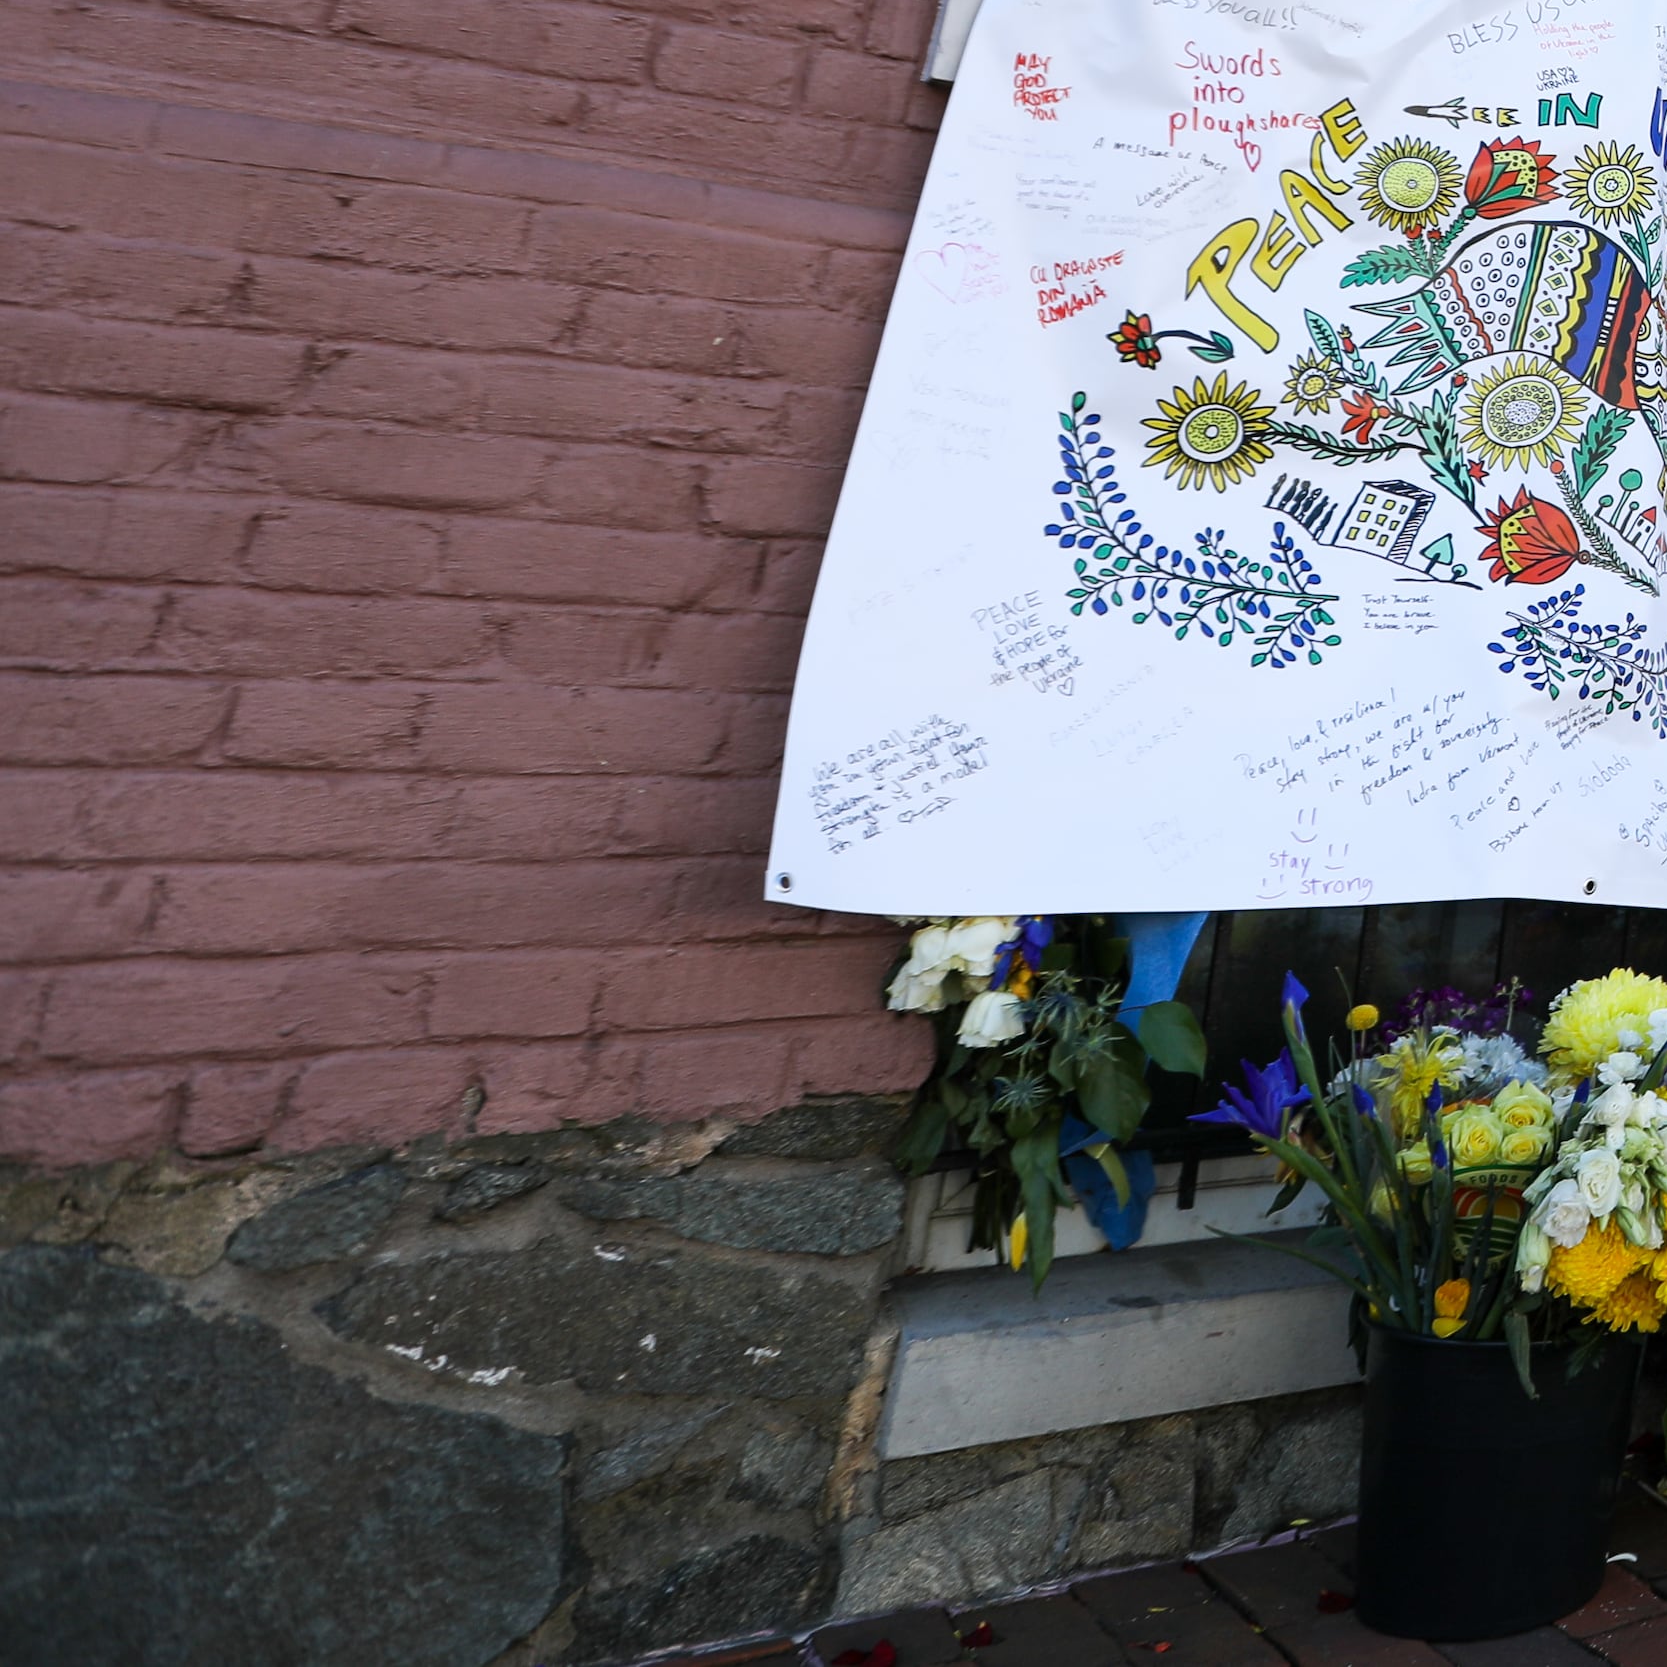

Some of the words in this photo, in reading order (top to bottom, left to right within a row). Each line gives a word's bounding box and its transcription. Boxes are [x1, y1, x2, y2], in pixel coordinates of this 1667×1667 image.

[1447, 11, 1519, 54] BLESS
[1014, 53, 1052, 73] MAY
[1175, 40, 1281, 77] Swords
[1014, 73, 1046, 88] GOD
[1536, 69, 1558, 81] USA
[1536, 75, 1580, 92] UKRAINE
[1013, 87, 1072, 107] PROTECT
[1193, 75, 1244, 104] into
[1025, 107, 1059, 121] YOU
[1168, 106, 1322, 150] ploughshares
[1092, 137, 1104, 150] A
[1185, 97, 1368, 353] PEACE
[1538, 92, 1603, 129] IN
[1030, 266, 1047, 283] CU
[1038, 282, 1066, 306] DIN
[971, 590, 1043, 631] PEACE
[994, 614, 1040, 645] LOVE
[1008, 633, 1047, 659] HOPE
[990, 669, 1015, 686] the
[1017, 654, 1055, 681] people
[1057, 644, 1072, 659] of
[1032, 655, 1083, 693] Ukraine
[1365, 730, 1383, 744] we
[1393, 714, 1412, 730] are
[1444, 691, 1465, 712] you
[1435, 713, 1454, 734] for
[879, 729, 907, 750] all
[1479, 733, 1519, 763] Vermont
[1361, 764, 1413, 805] freedom
[1269, 850, 1311, 876] stay
[1300, 874, 1373, 902] strong
